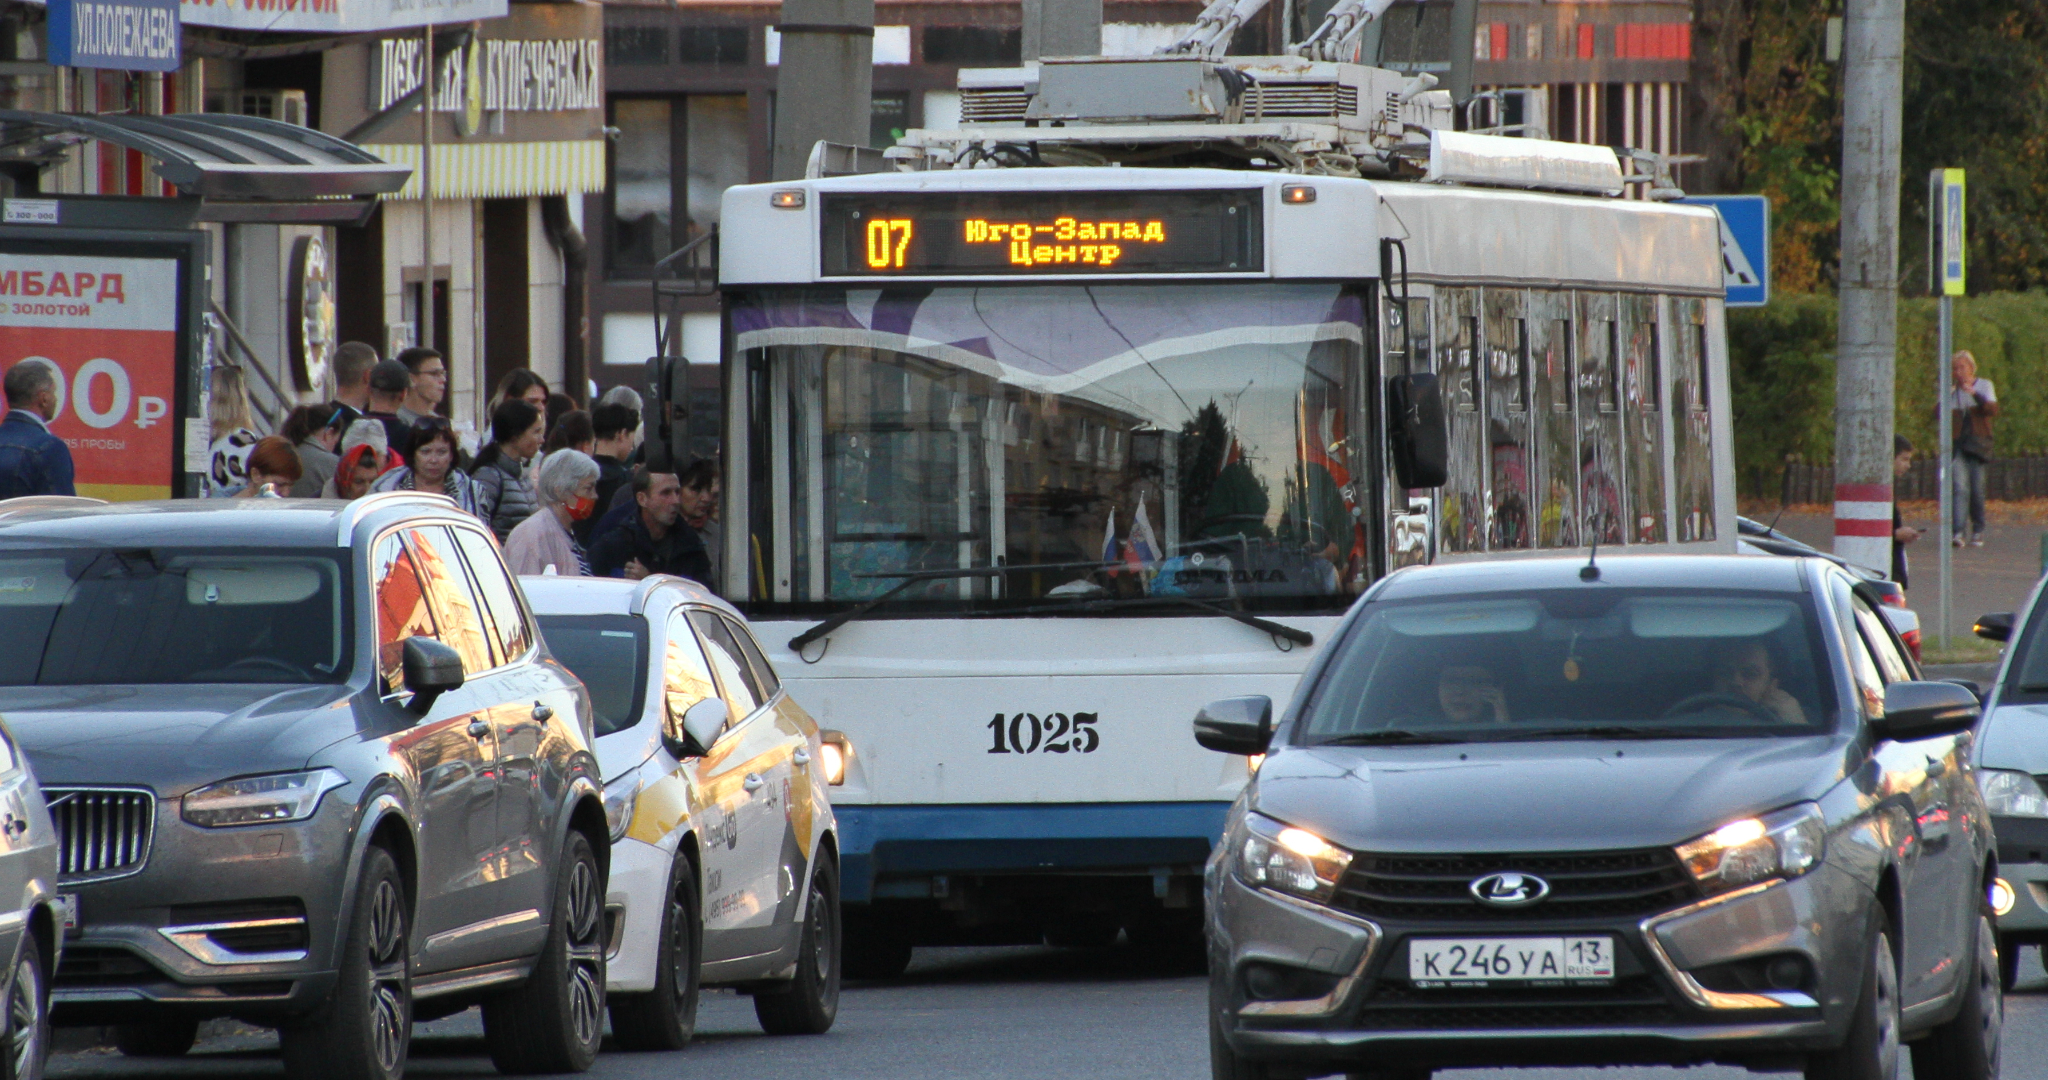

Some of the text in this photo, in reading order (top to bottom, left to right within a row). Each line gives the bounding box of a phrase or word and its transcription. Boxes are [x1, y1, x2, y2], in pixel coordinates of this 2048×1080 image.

[485, 39, 600, 134] КУПЕЧЕСКАЯ
[867, 218, 1165, 268] 07 Юго-Запад
[1011, 241, 1121, 266] Центр
[81, 439, 125, 450] ПРОБЫ
[987, 712, 1099, 754] 1025
[1571, 941, 1600, 964] 13
[1568, 966, 1591, 975] RUS
